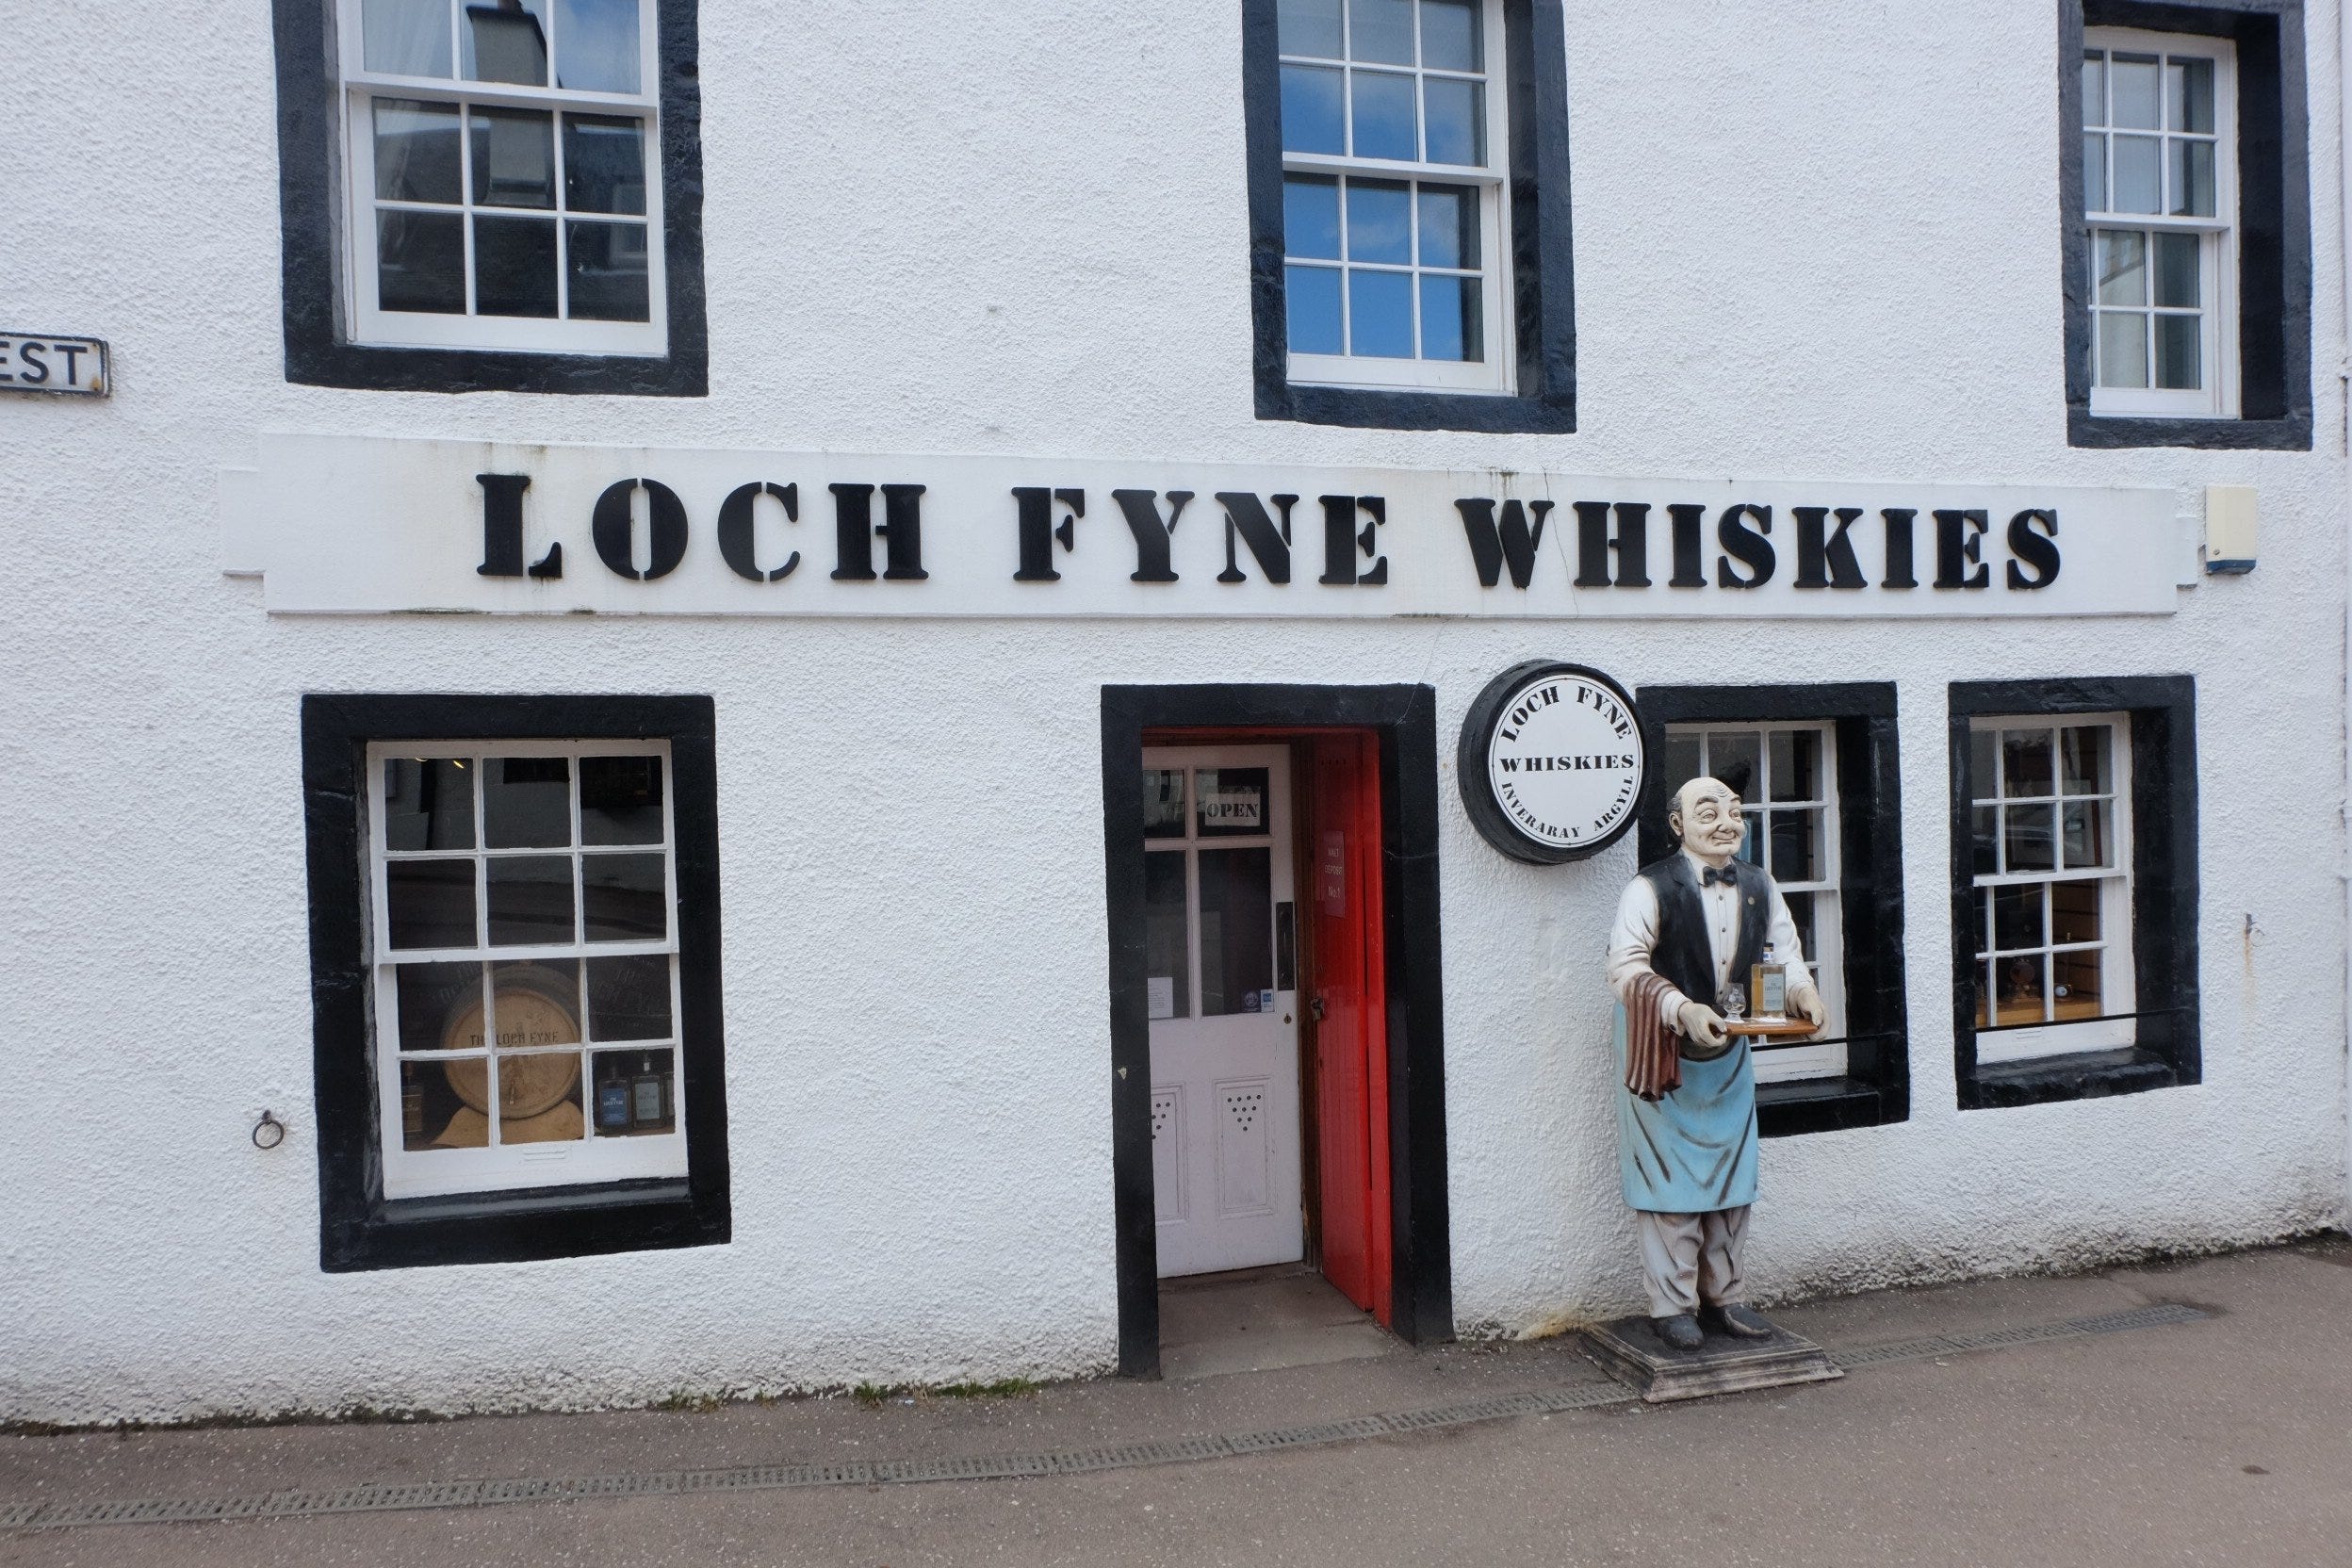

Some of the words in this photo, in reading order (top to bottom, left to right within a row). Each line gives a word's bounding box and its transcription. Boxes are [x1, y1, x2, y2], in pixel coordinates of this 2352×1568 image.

[476, 474, 929, 582] LOCH
[1011, 486, 1388, 585] FYNE
[1454, 498, 2061, 590] WHISKIES
[1501, 686, 1560, 743] LOCH
[1576, 686, 1632, 740] FYNE
[1500, 755, 1634, 772] WHISKIES
[1207, 803, 1259, 818] OPEN
[1502, 782, 1580, 838] INVERARAY
[1594, 776, 1633, 831] ARGYLL
